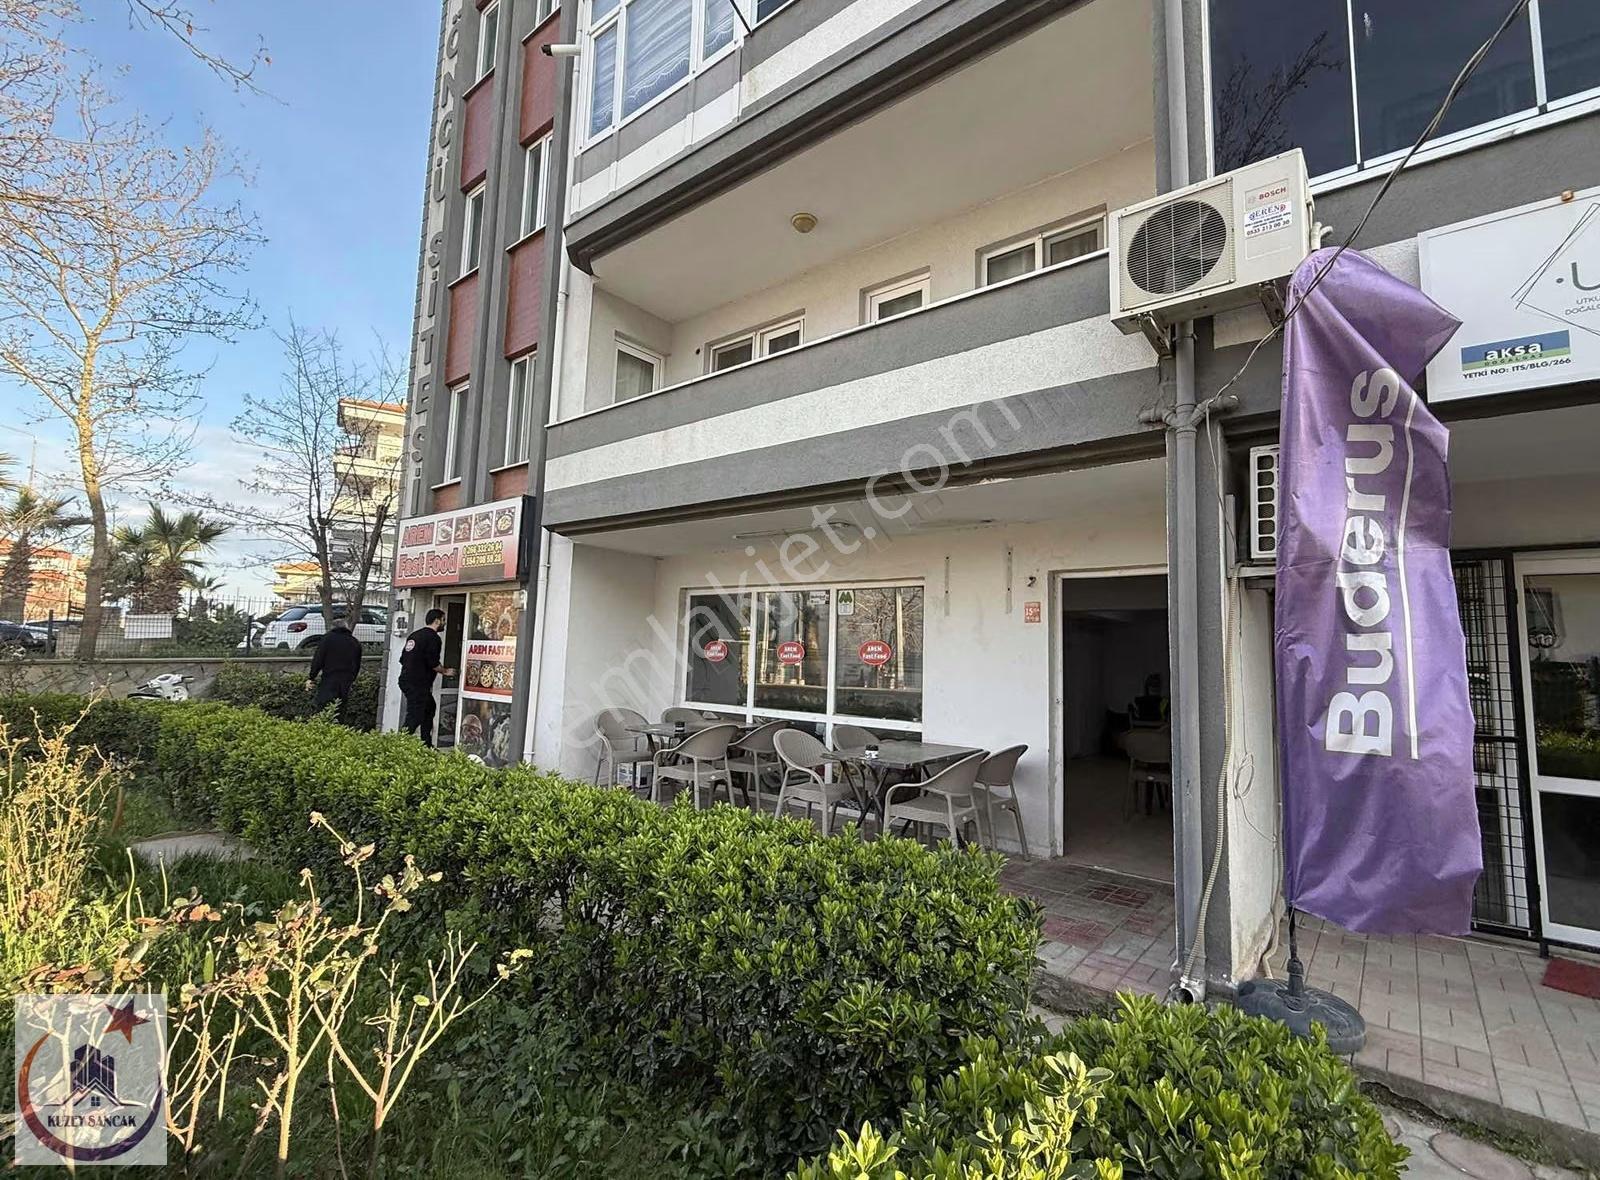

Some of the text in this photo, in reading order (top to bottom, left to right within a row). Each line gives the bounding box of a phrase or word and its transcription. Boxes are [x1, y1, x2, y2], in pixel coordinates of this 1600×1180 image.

[1259, 187, 1286, 200] BOSCH
[1485, 342, 1543, 361] aksa
[1463, 370, 1488, 380] YETKİ
[1490, 367, 1509, 376] NO:
[400, 521, 434, 548] AREM
[398, 547, 459, 578] Fast Food
[1325, 366, 1401, 757] Buderus
[469, 644, 487, 655] AREM
[488, 645, 505, 656] FAST
